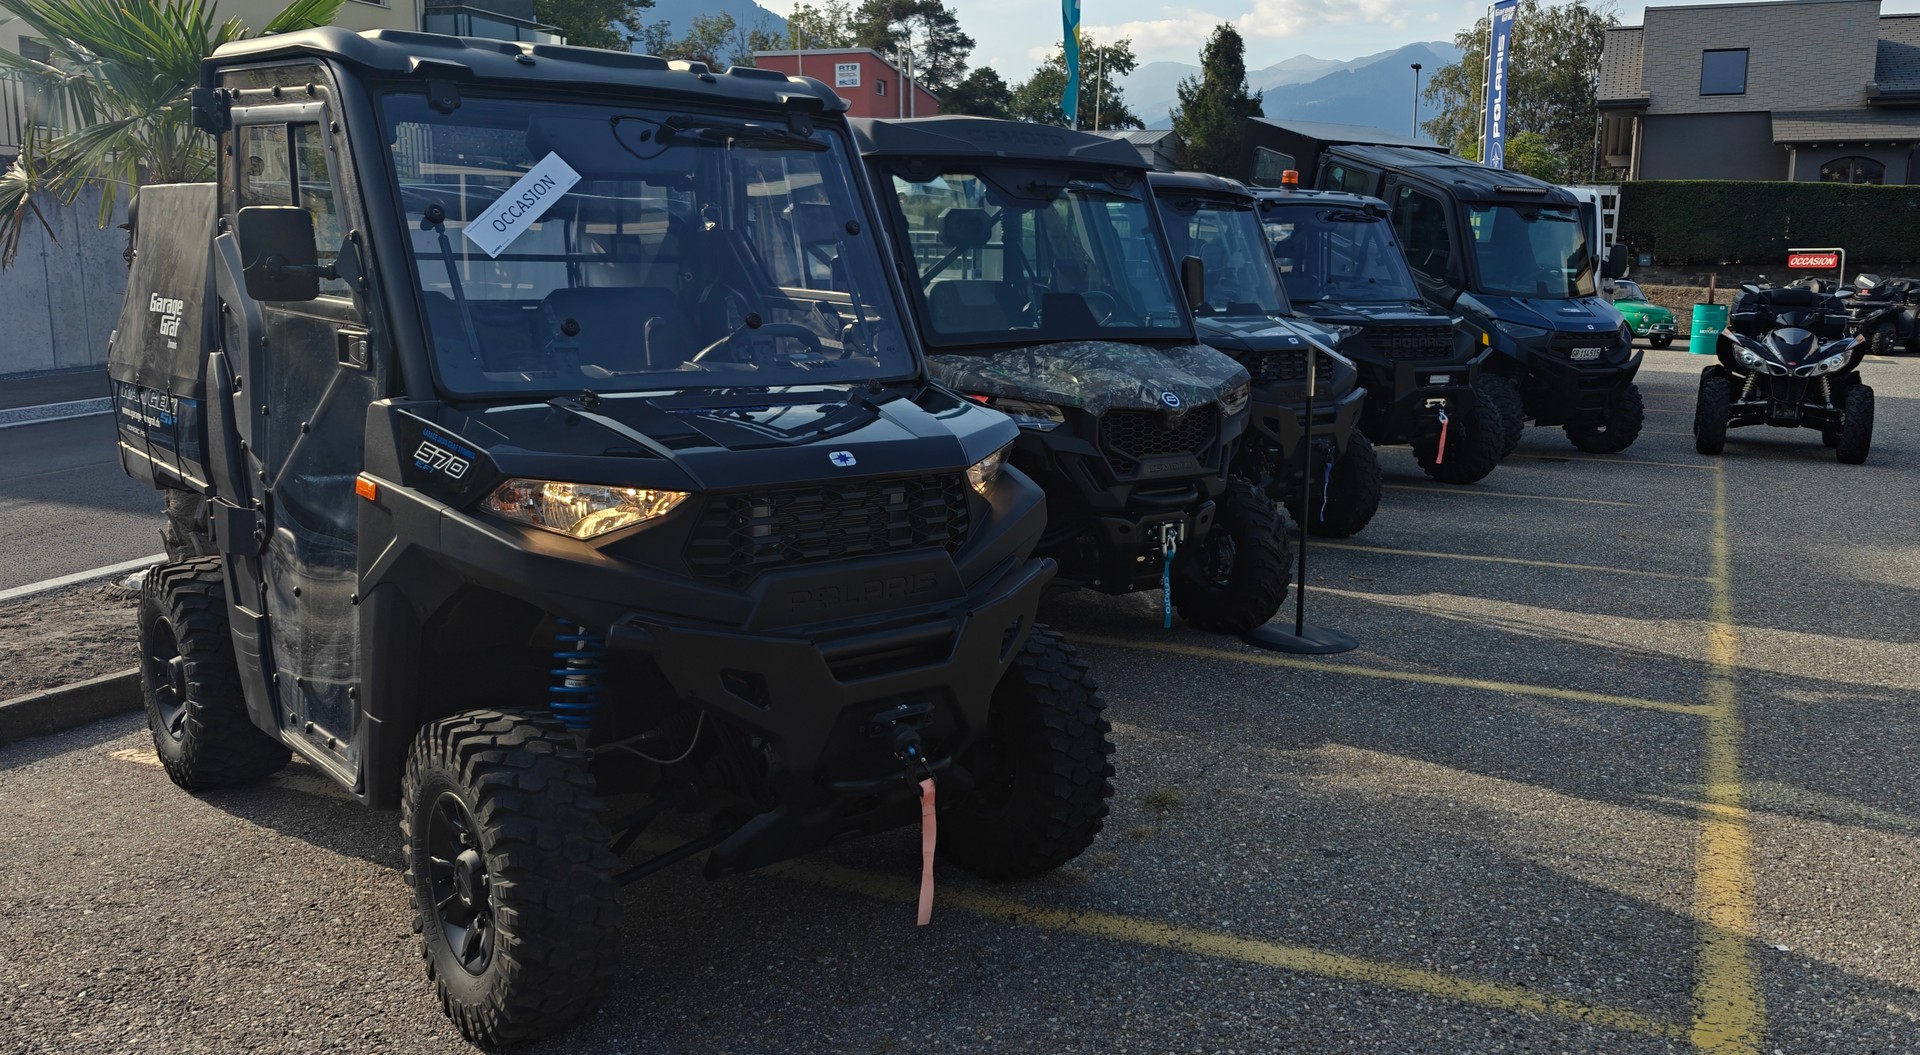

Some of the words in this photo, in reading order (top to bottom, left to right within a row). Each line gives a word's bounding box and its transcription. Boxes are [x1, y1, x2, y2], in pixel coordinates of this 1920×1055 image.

[1493, 34, 1506, 138] POLARIS
[492, 174, 556, 233] OCCASION
[1790, 257, 1836, 266] OCCASION
[149, 292, 184, 318] Garage
[159, 314, 181, 337] Graf
[1392, 337, 1446, 348] POLARIS
[413, 440, 470, 479] 570
[415, 459, 435, 474] EFI
[787, 571, 937, 612] POLARIS
